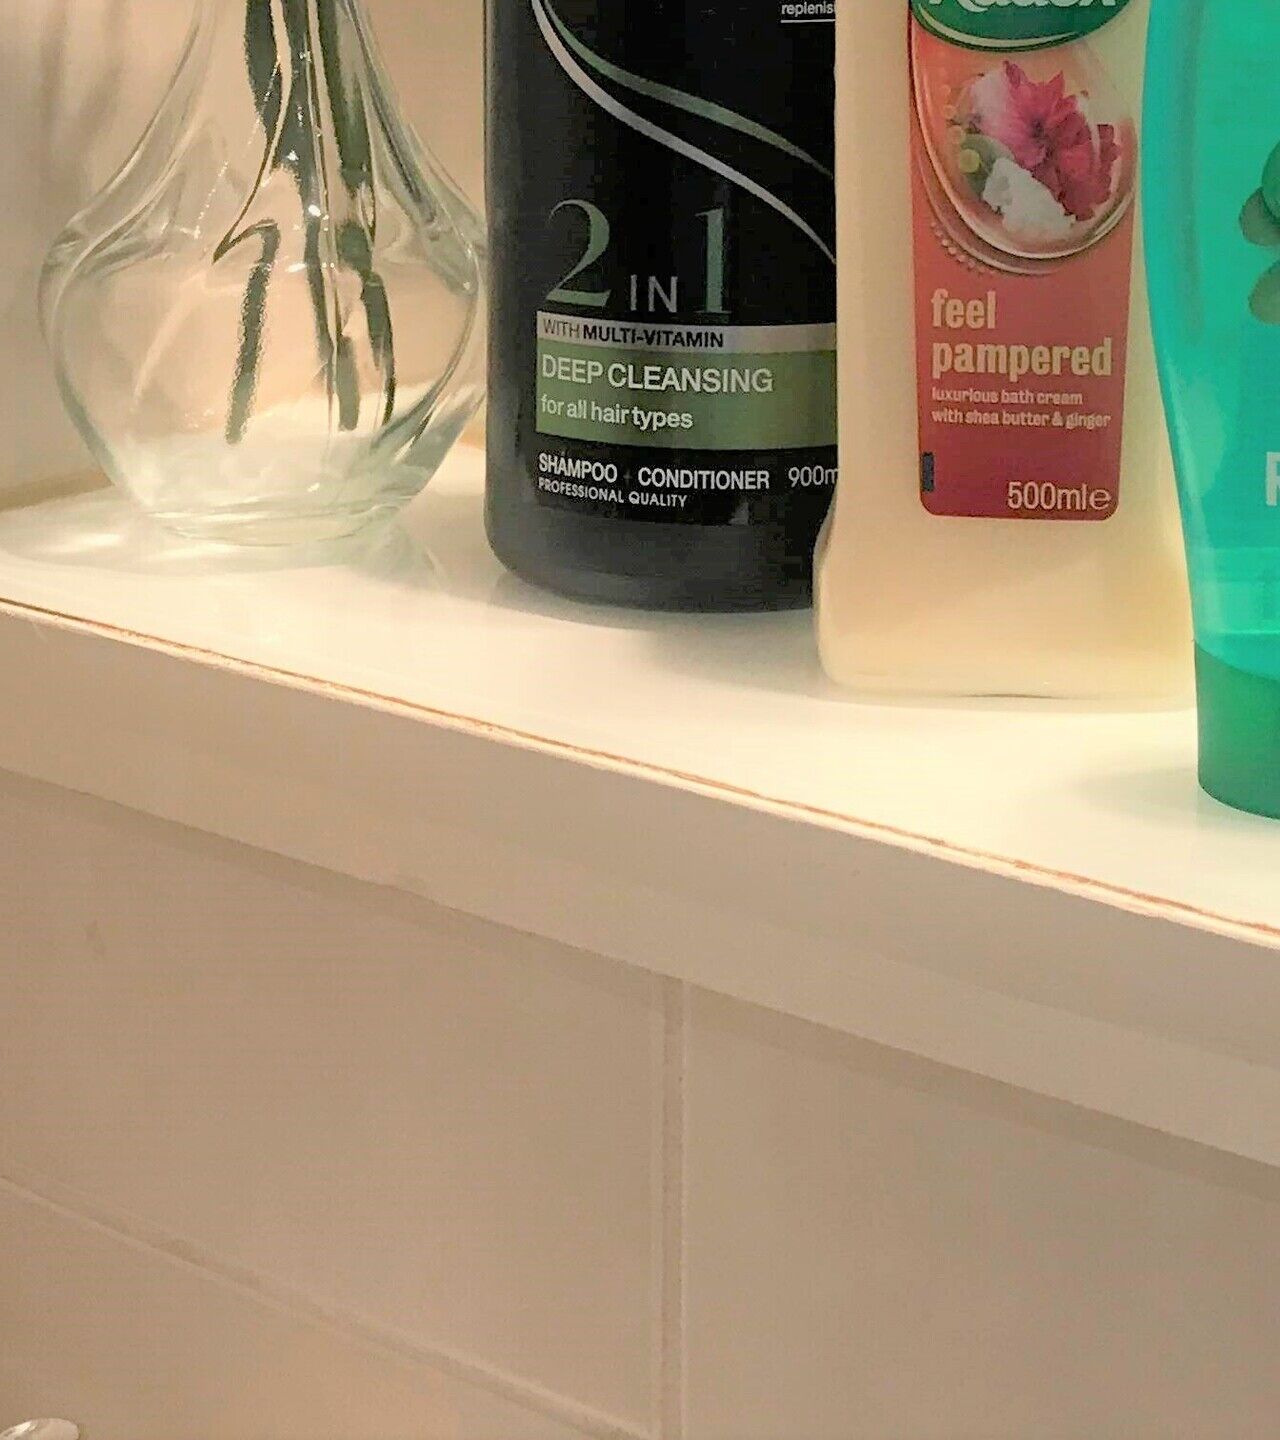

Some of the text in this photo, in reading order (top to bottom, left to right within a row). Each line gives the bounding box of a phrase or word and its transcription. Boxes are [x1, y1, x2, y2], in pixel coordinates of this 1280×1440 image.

[781, 0, 836, 18] replenis
[544, 198, 733, 314] 2 IN 1
[930, 288, 997, 329] feel
[542, 318, 725, 349] WITH MULTI-VITAMIN
[542, 354, 775, 394] DEEP CLEANSING
[931, 337, 1113, 383] pampered
[540, 394, 694, 431] for all hair types
[931, 386, 1084, 405] luxurious bath cream
[931, 408, 1112, 431] with shea butter & ginger
[538, 452, 619, 483] SHAMPOO
[637, 466, 770, 490] CONDITIONER
[538, 476, 688, 508] PROFESSIONAL QUALITY
